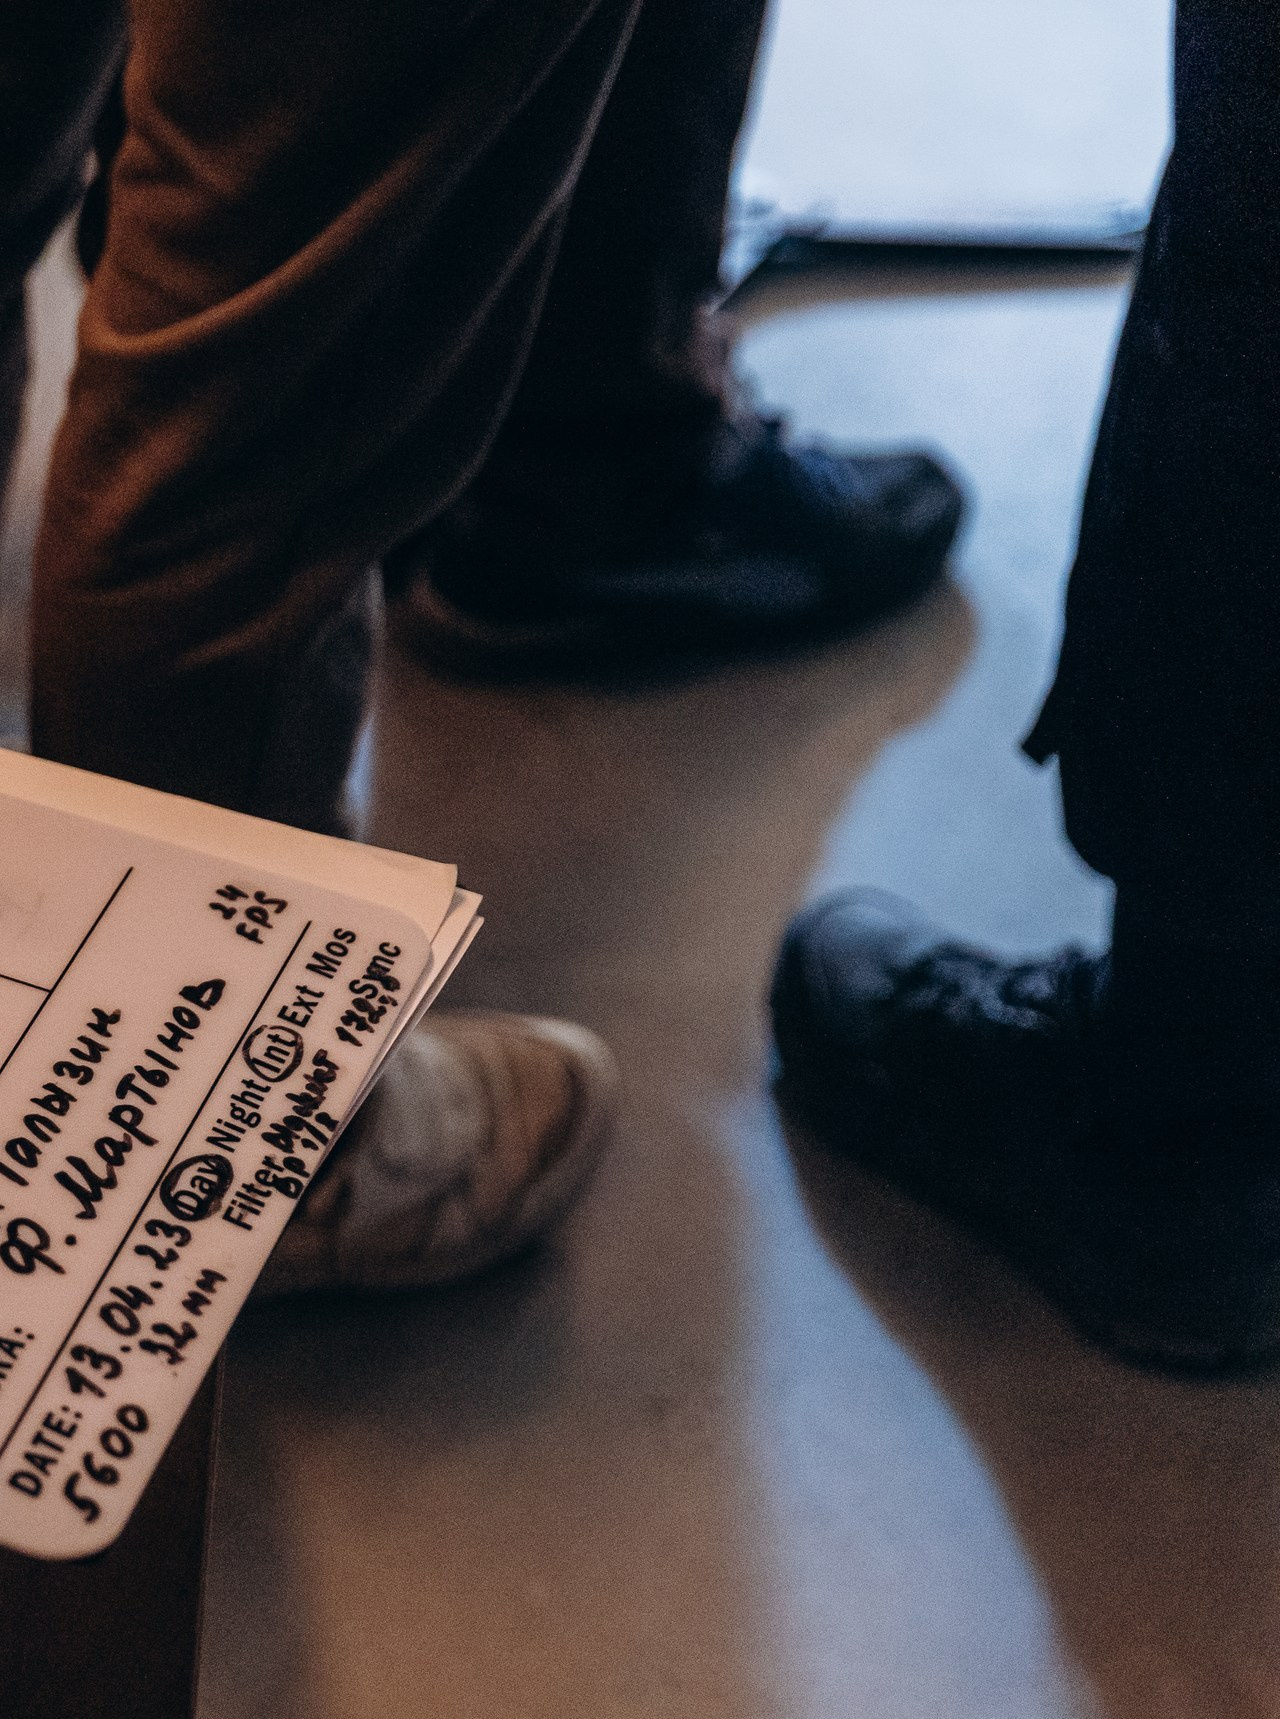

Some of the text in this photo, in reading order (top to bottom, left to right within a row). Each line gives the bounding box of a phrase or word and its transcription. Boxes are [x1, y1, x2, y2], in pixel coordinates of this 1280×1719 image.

[235, 890, 288, 945] FPS
[348, 942, 402, 1006] Sync
[53, 978, 227, 1221] Мартынов
[172, 928, 357, 1215] Day Night Int Ext Mos
[221, 1155, 289, 1231] Filter
[8, 1406, 82, 1498] DATE:
[62, 1404, 150, 1524] 5600
